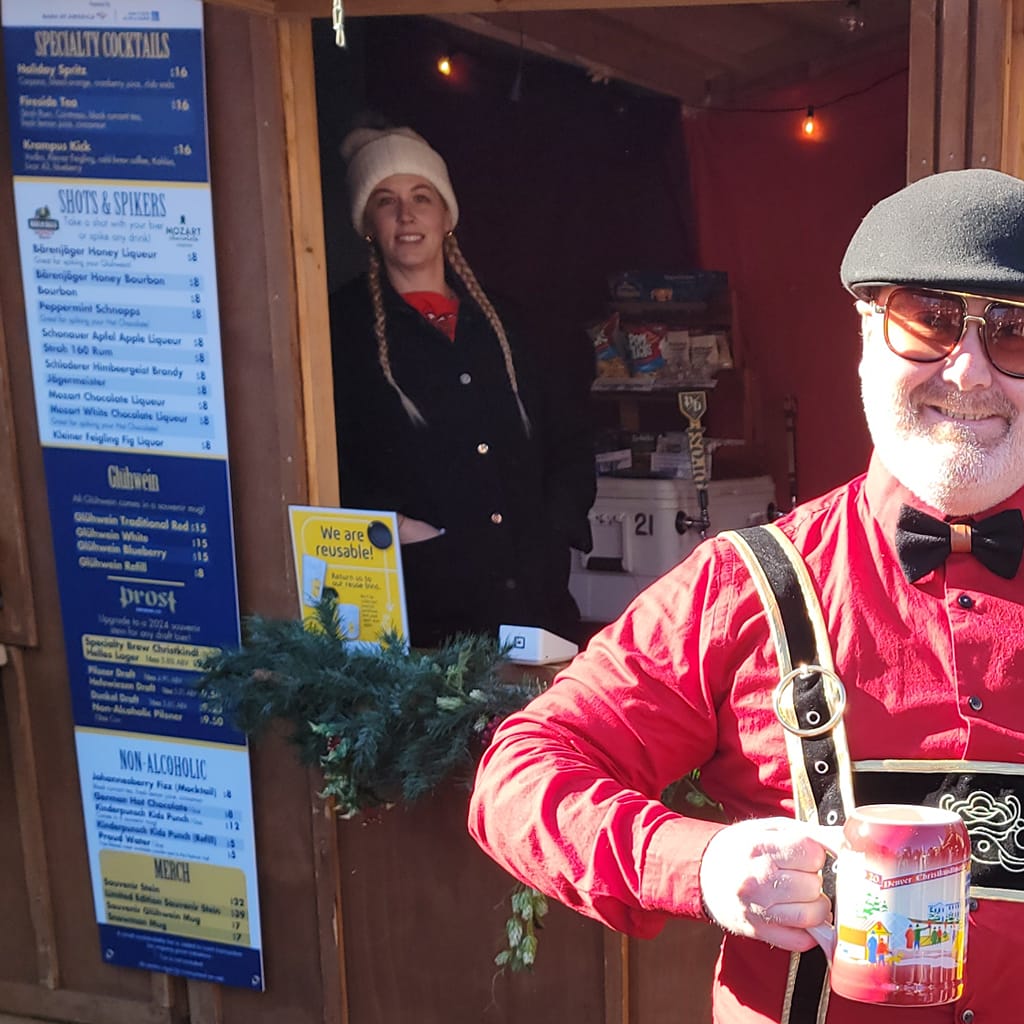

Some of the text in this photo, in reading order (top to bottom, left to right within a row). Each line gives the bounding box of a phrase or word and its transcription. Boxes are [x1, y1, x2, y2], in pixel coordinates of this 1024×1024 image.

[34, 31, 170, 59] SPECIALTY COCKTAILS
[17, 64, 55, 76] Holiday
[58, 65, 87, 77] Spritz
[58, 189, 166, 217] SHOTS & SPIKERS
[88, 247, 118, 258] Honey
[122, 248, 157, 259] Liqueur
[108, 465, 160, 492] Glühwein
[320, 526, 364, 542] We are
[634, 512, 653, 536] 21
[316, 544, 374, 560] reusable!
[120, 586, 176, 613] prost
[119, 749, 208, 780] NON-ALCOHOLIC
[154, 858, 190, 883] MERCH
